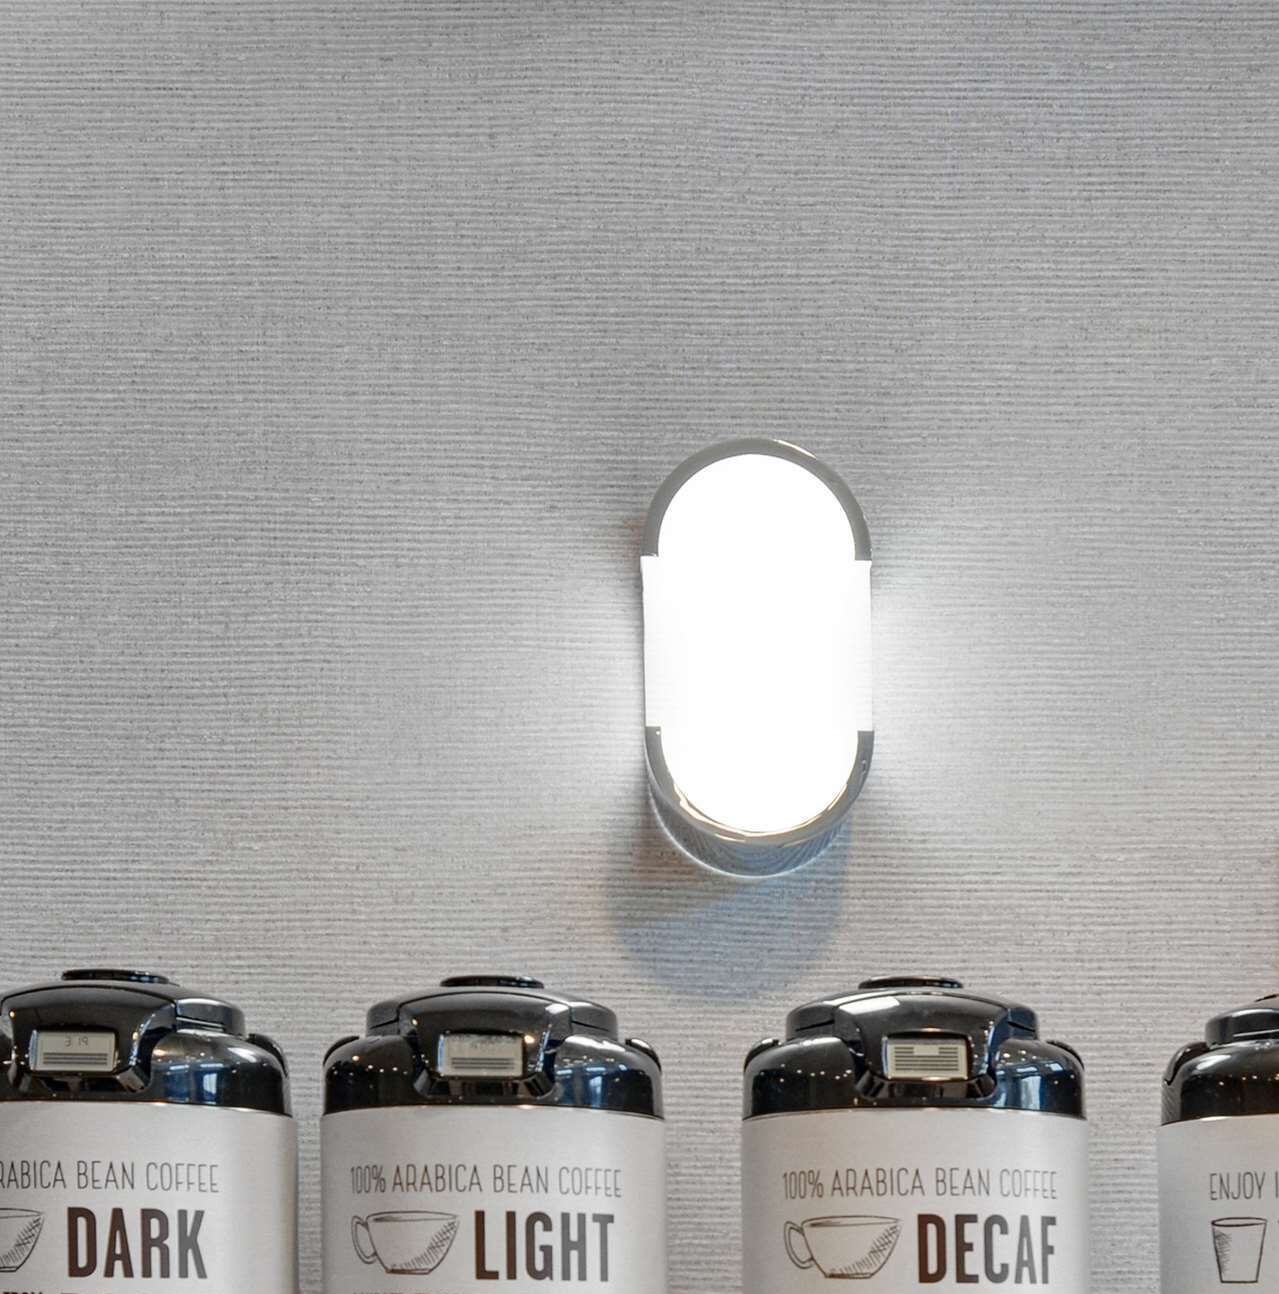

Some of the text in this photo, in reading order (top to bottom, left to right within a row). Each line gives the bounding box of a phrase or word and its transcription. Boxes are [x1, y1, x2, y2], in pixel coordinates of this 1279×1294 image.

[77, 1161, 135, 1190] BEAN
[146, 1162, 220, 1193] COFFEE
[351, 1164, 622, 1198] 100% ARABICA BEAN COFFEE
[782, 1168, 1058, 1200] 100% ARABICA BEAN COFFEE
[1209, 1171, 1266, 1201] ENJOY
[67, 1207, 208, 1279] DARK
[475, 1210, 614, 1282] LIGHT
[917, 1213, 1057, 1284] DECAF
